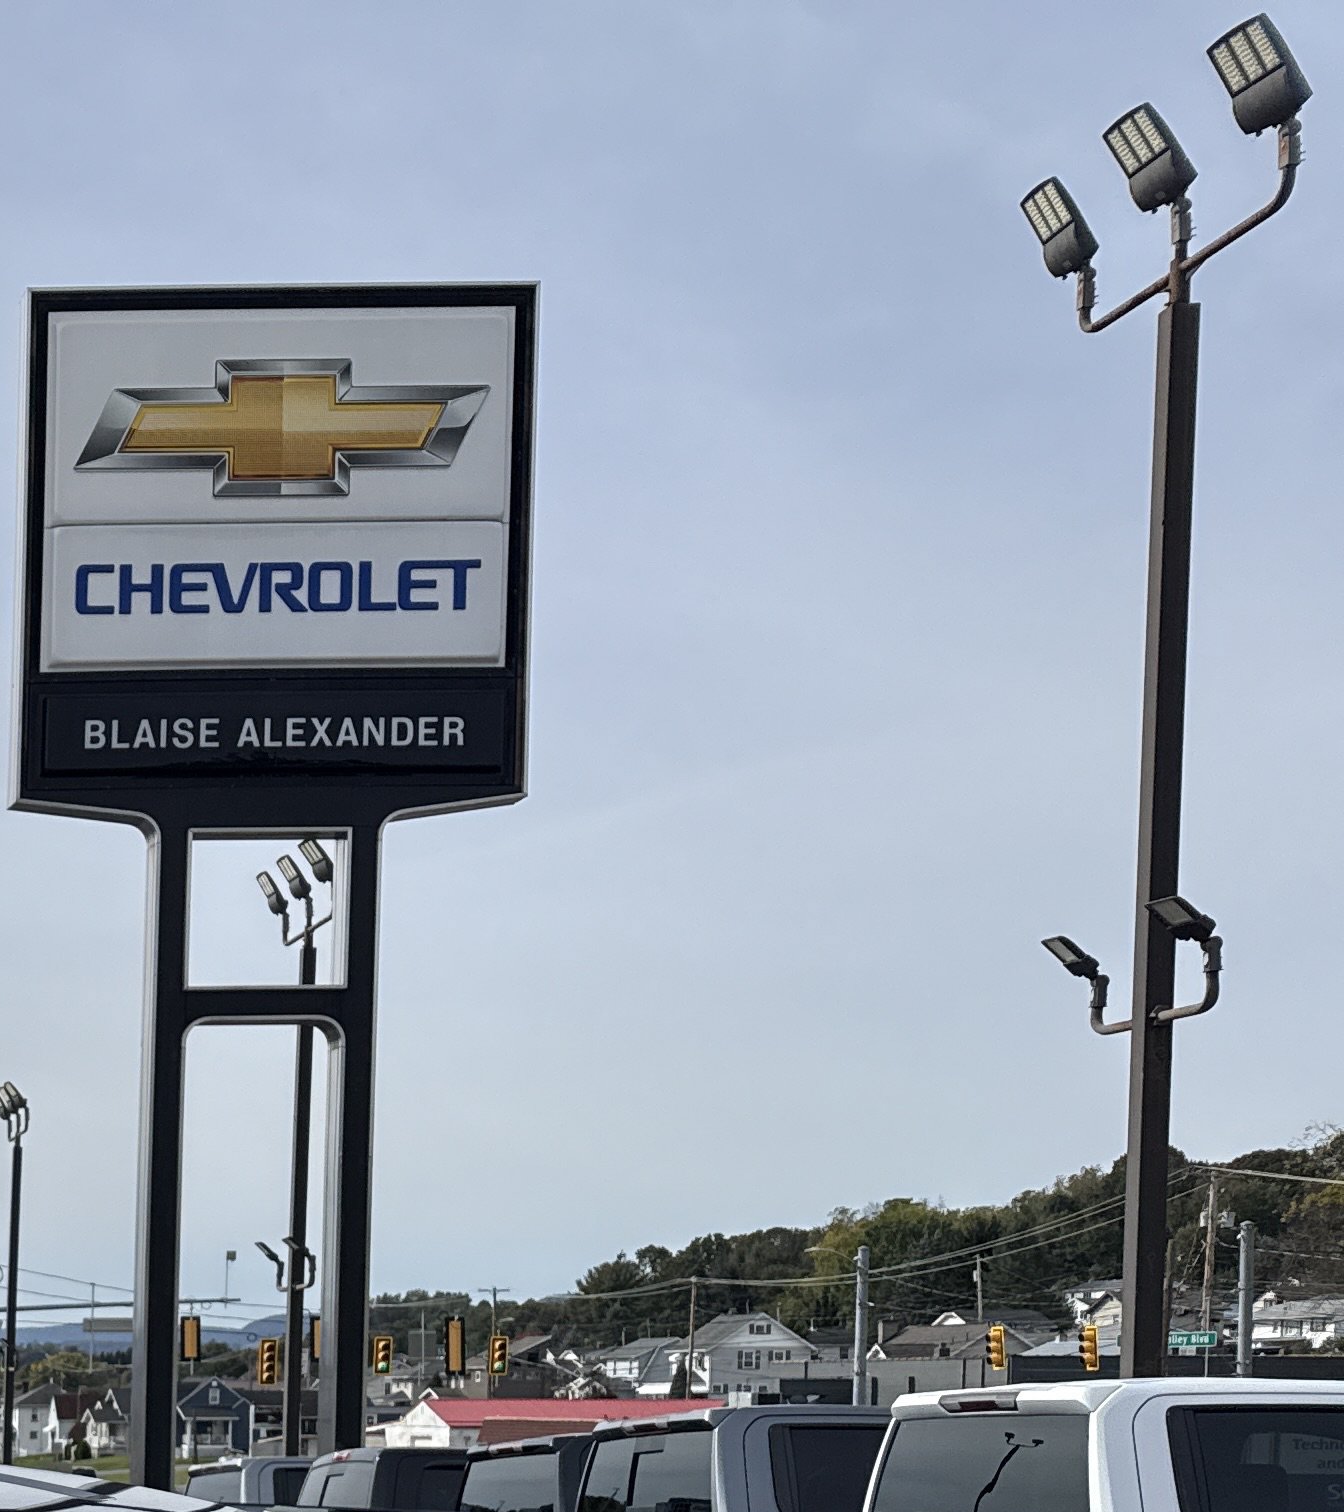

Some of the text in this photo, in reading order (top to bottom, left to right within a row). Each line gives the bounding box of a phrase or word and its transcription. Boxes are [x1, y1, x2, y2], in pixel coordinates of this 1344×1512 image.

[75, 558, 482, 616] CHEVROLET
[84, 715, 466, 750] BLAISE ALEXANDER
